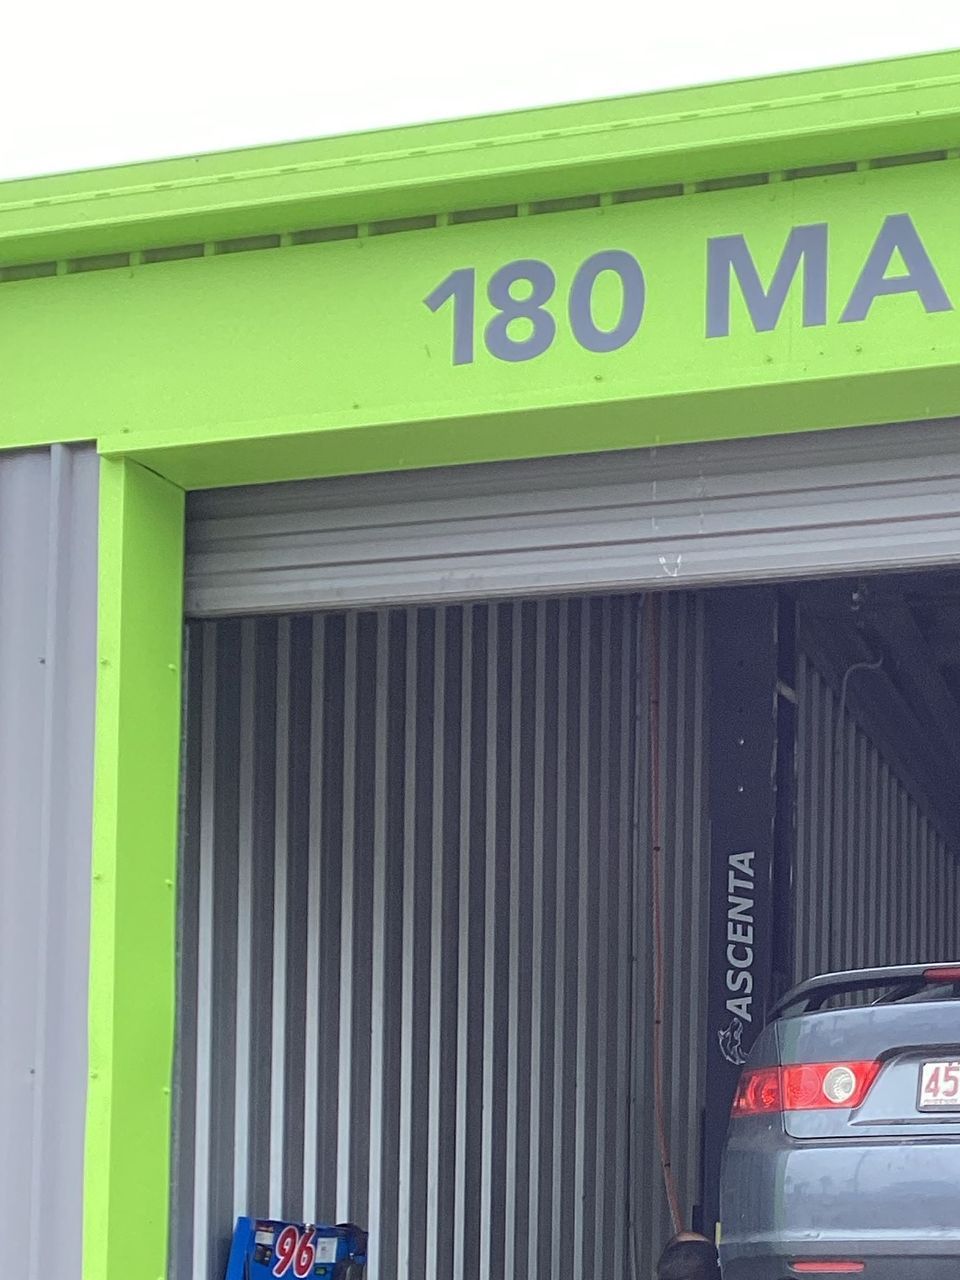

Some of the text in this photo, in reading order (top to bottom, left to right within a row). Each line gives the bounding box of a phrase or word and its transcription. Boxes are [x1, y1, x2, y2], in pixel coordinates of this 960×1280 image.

[422, 249, 646, 367] 180
[726, 851, 755, 1023] ASCENTA
[272, 1225, 316, 1279] 96
